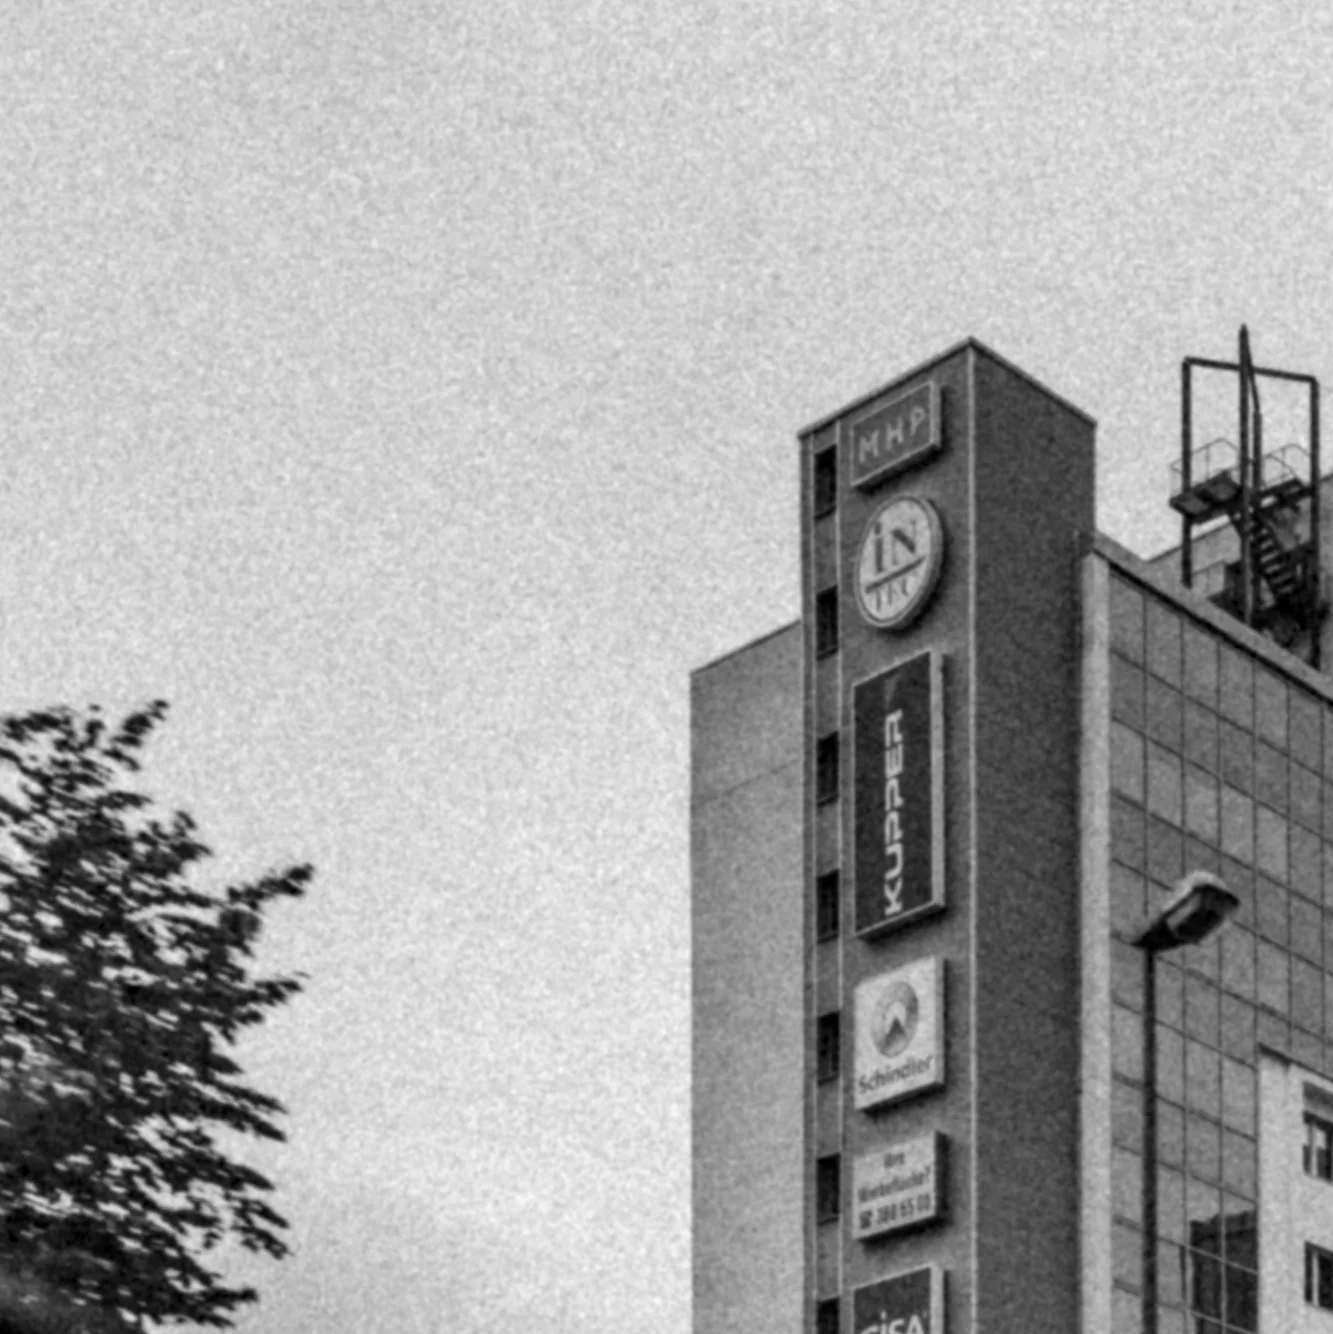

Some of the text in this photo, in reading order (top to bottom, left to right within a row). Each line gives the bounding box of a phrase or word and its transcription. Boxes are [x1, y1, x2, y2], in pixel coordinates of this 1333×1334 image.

[859, 406, 927, 464] MHP
[884, 710, 904, 916] KUPPER
[858, 1053, 934, 1095] Schindler
